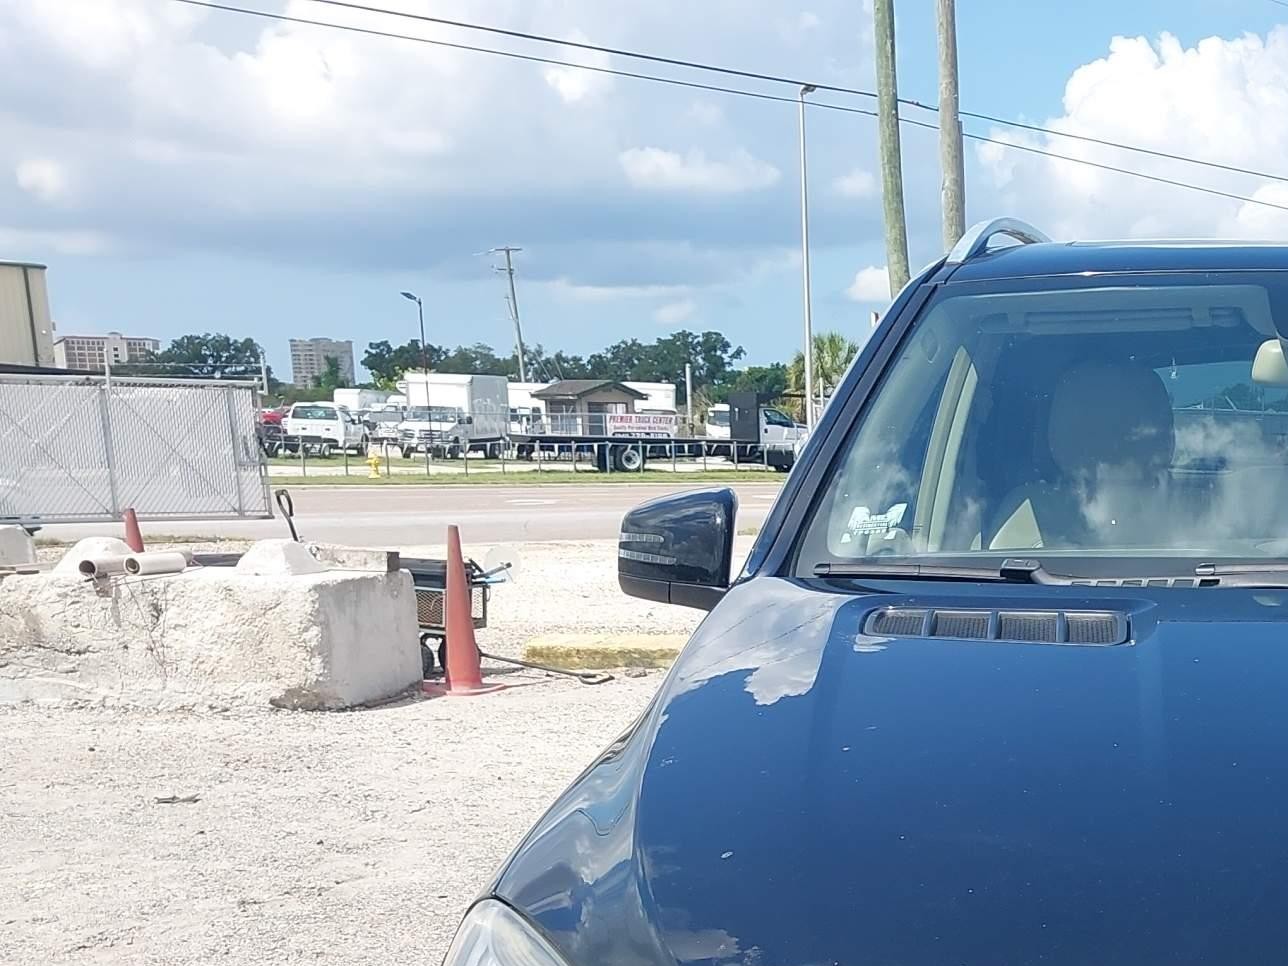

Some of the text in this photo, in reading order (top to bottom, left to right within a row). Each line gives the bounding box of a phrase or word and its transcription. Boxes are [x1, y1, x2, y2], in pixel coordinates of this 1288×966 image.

[609, 415, 673, 425] PREMIER TRUCK CENTER
